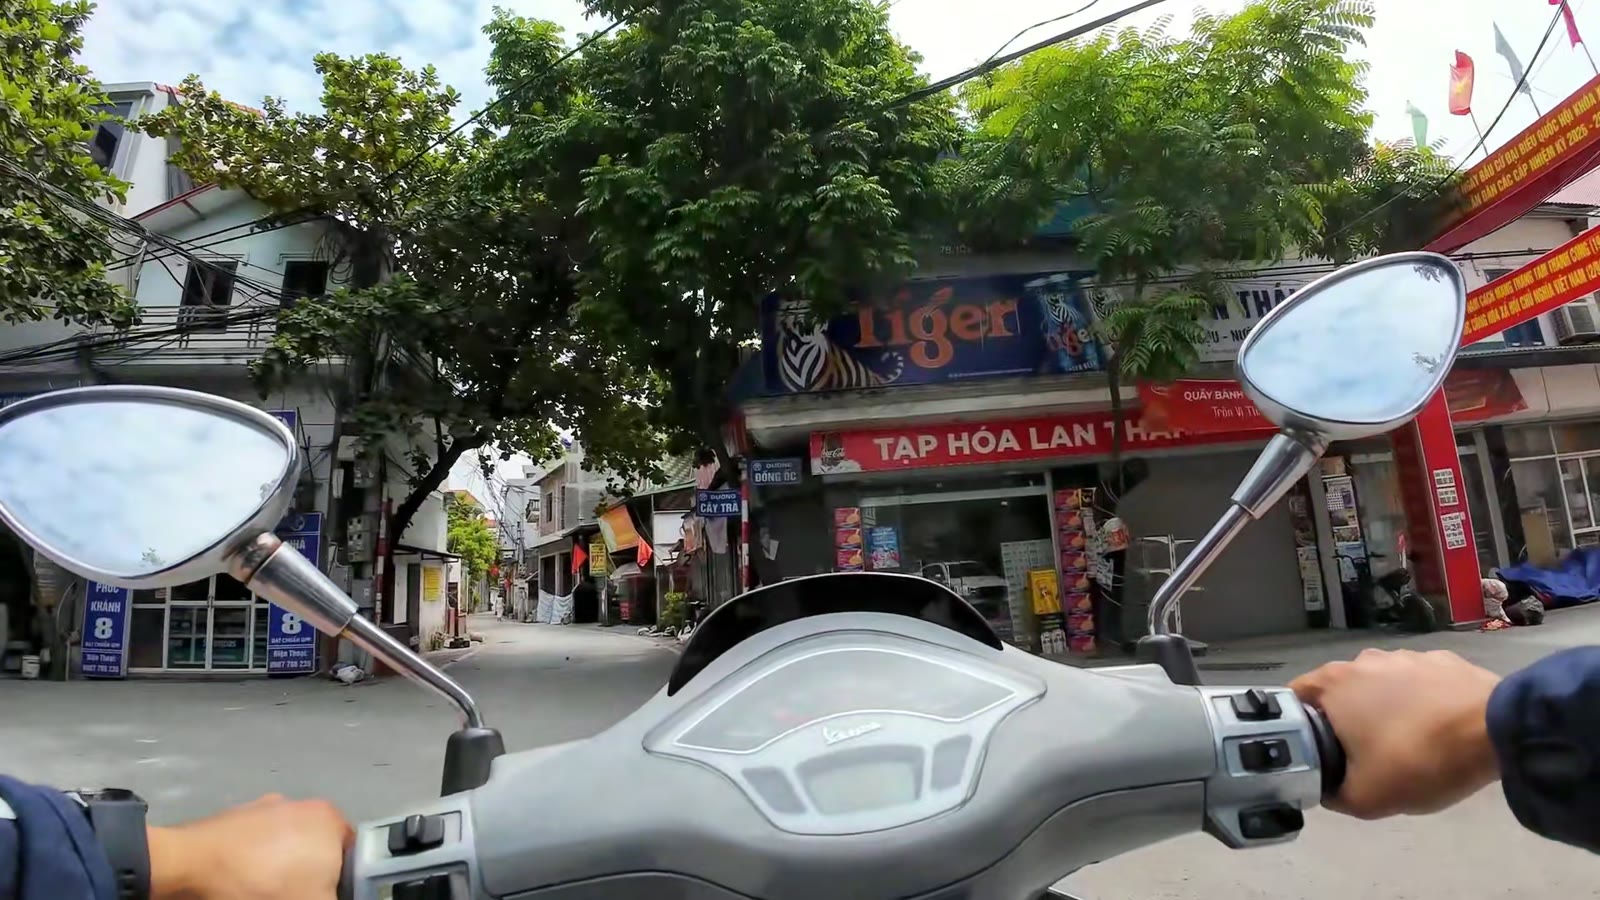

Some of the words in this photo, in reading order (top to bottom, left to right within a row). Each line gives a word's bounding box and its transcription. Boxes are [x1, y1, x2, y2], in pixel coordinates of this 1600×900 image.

[1497, 173, 1513, 192] CÁC
[853, 286, 1018, 370] Tiger
[873, 434, 938, 464] TẠP
[947, 425, 1022, 456] HÓA
[1028, 422, 1097, 450] LAN
[700, 501, 718, 513] CÂY
[91, 599, 121, 613] KHÁNH
[94, 617, 113, 639] 8
[282, 612, 302, 635] 8
